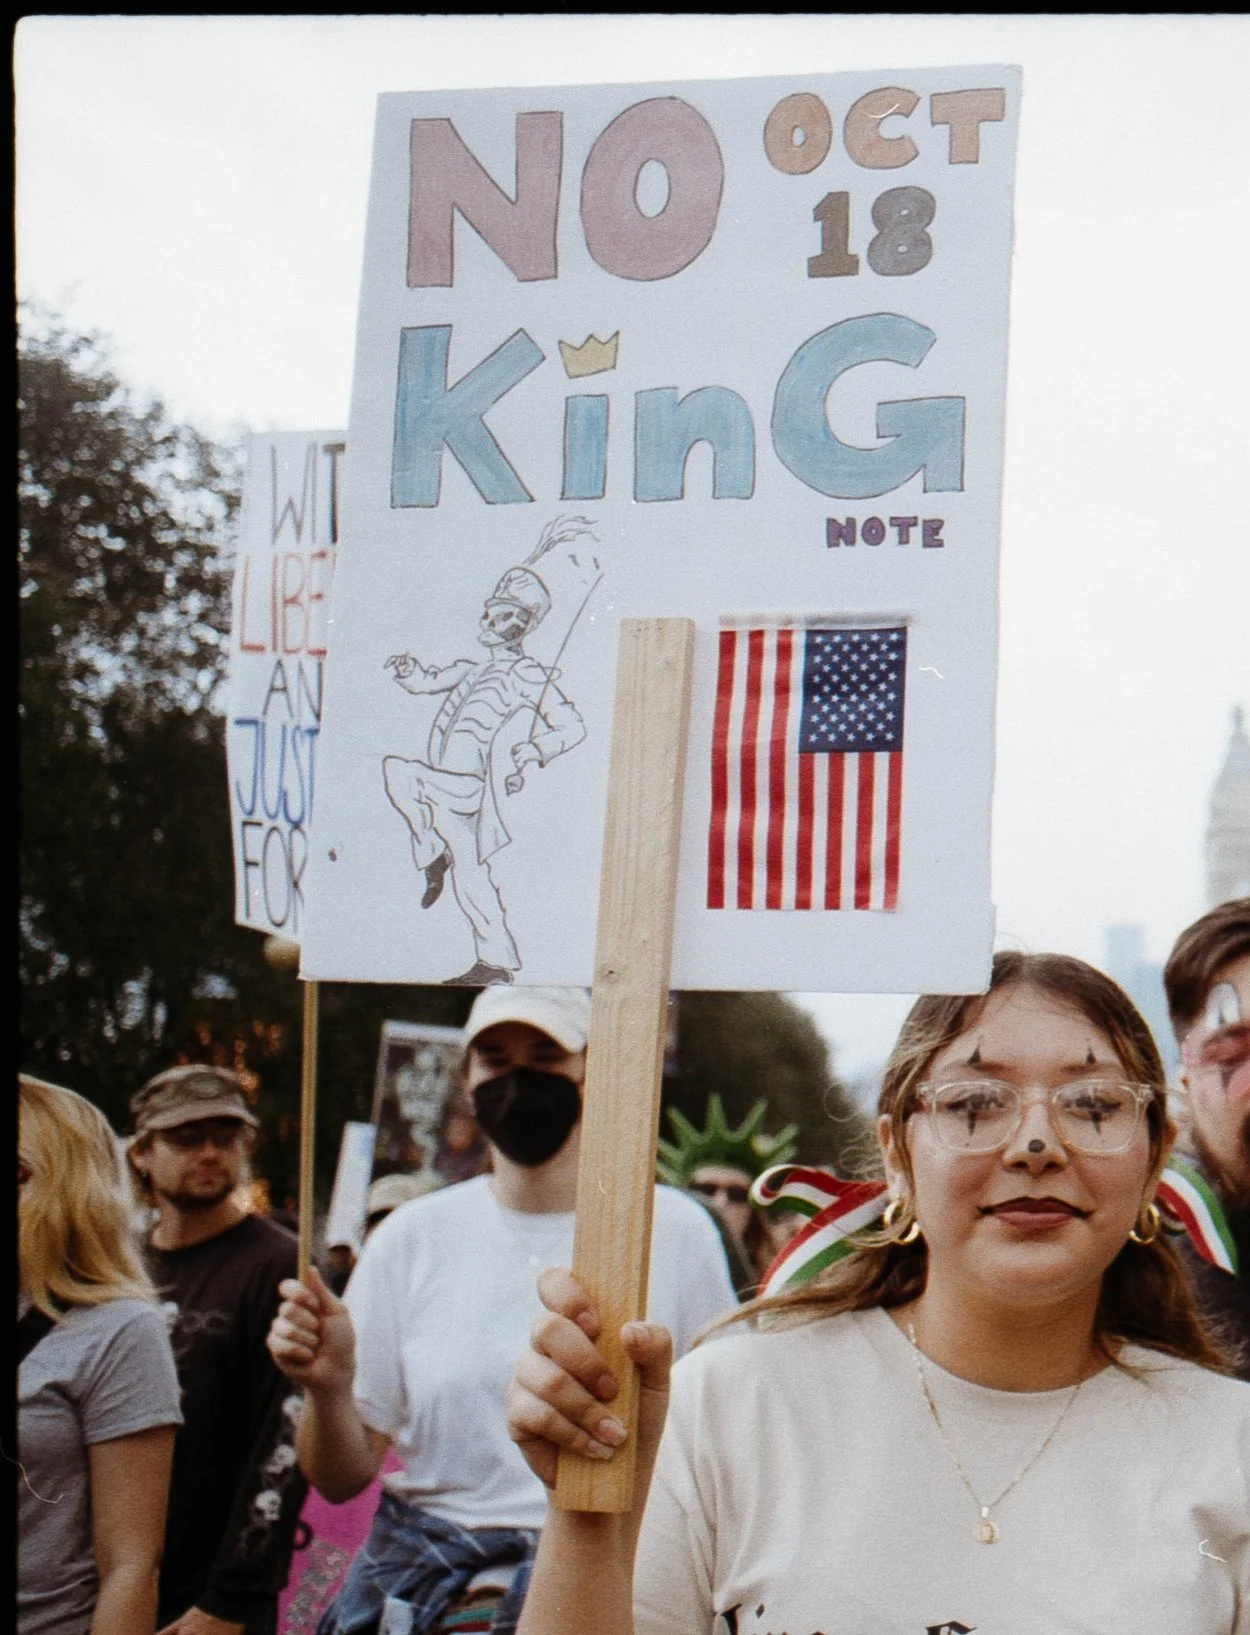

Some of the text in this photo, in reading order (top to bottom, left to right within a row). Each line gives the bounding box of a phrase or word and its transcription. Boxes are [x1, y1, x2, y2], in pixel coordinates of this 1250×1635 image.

[763, 86, 1006, 175] OCT
[406, 96, 725, 289] NO
[806, 185, 937, 278] 18
[390, 312, 966, 509] KinG
[826, 515, 945, 549] NOTE
[240, 550, 336, 657] LIBE
